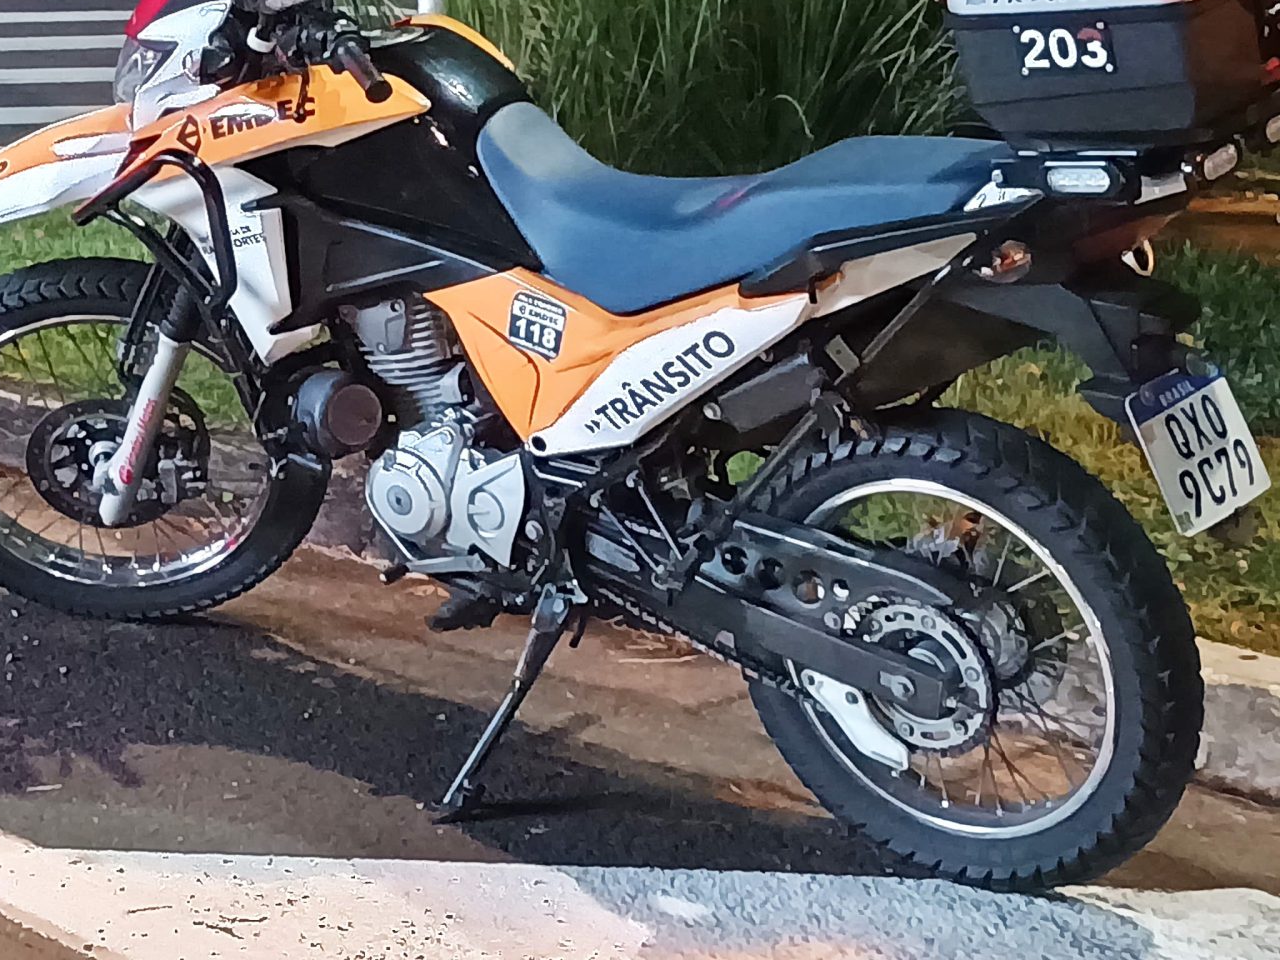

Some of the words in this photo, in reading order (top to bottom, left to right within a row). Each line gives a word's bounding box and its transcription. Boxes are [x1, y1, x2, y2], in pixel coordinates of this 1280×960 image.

[1020, 28, 1108, 69] 203
[515, 317, 557, 349] 118
[1178, 438, 1255, 518] 9C79
